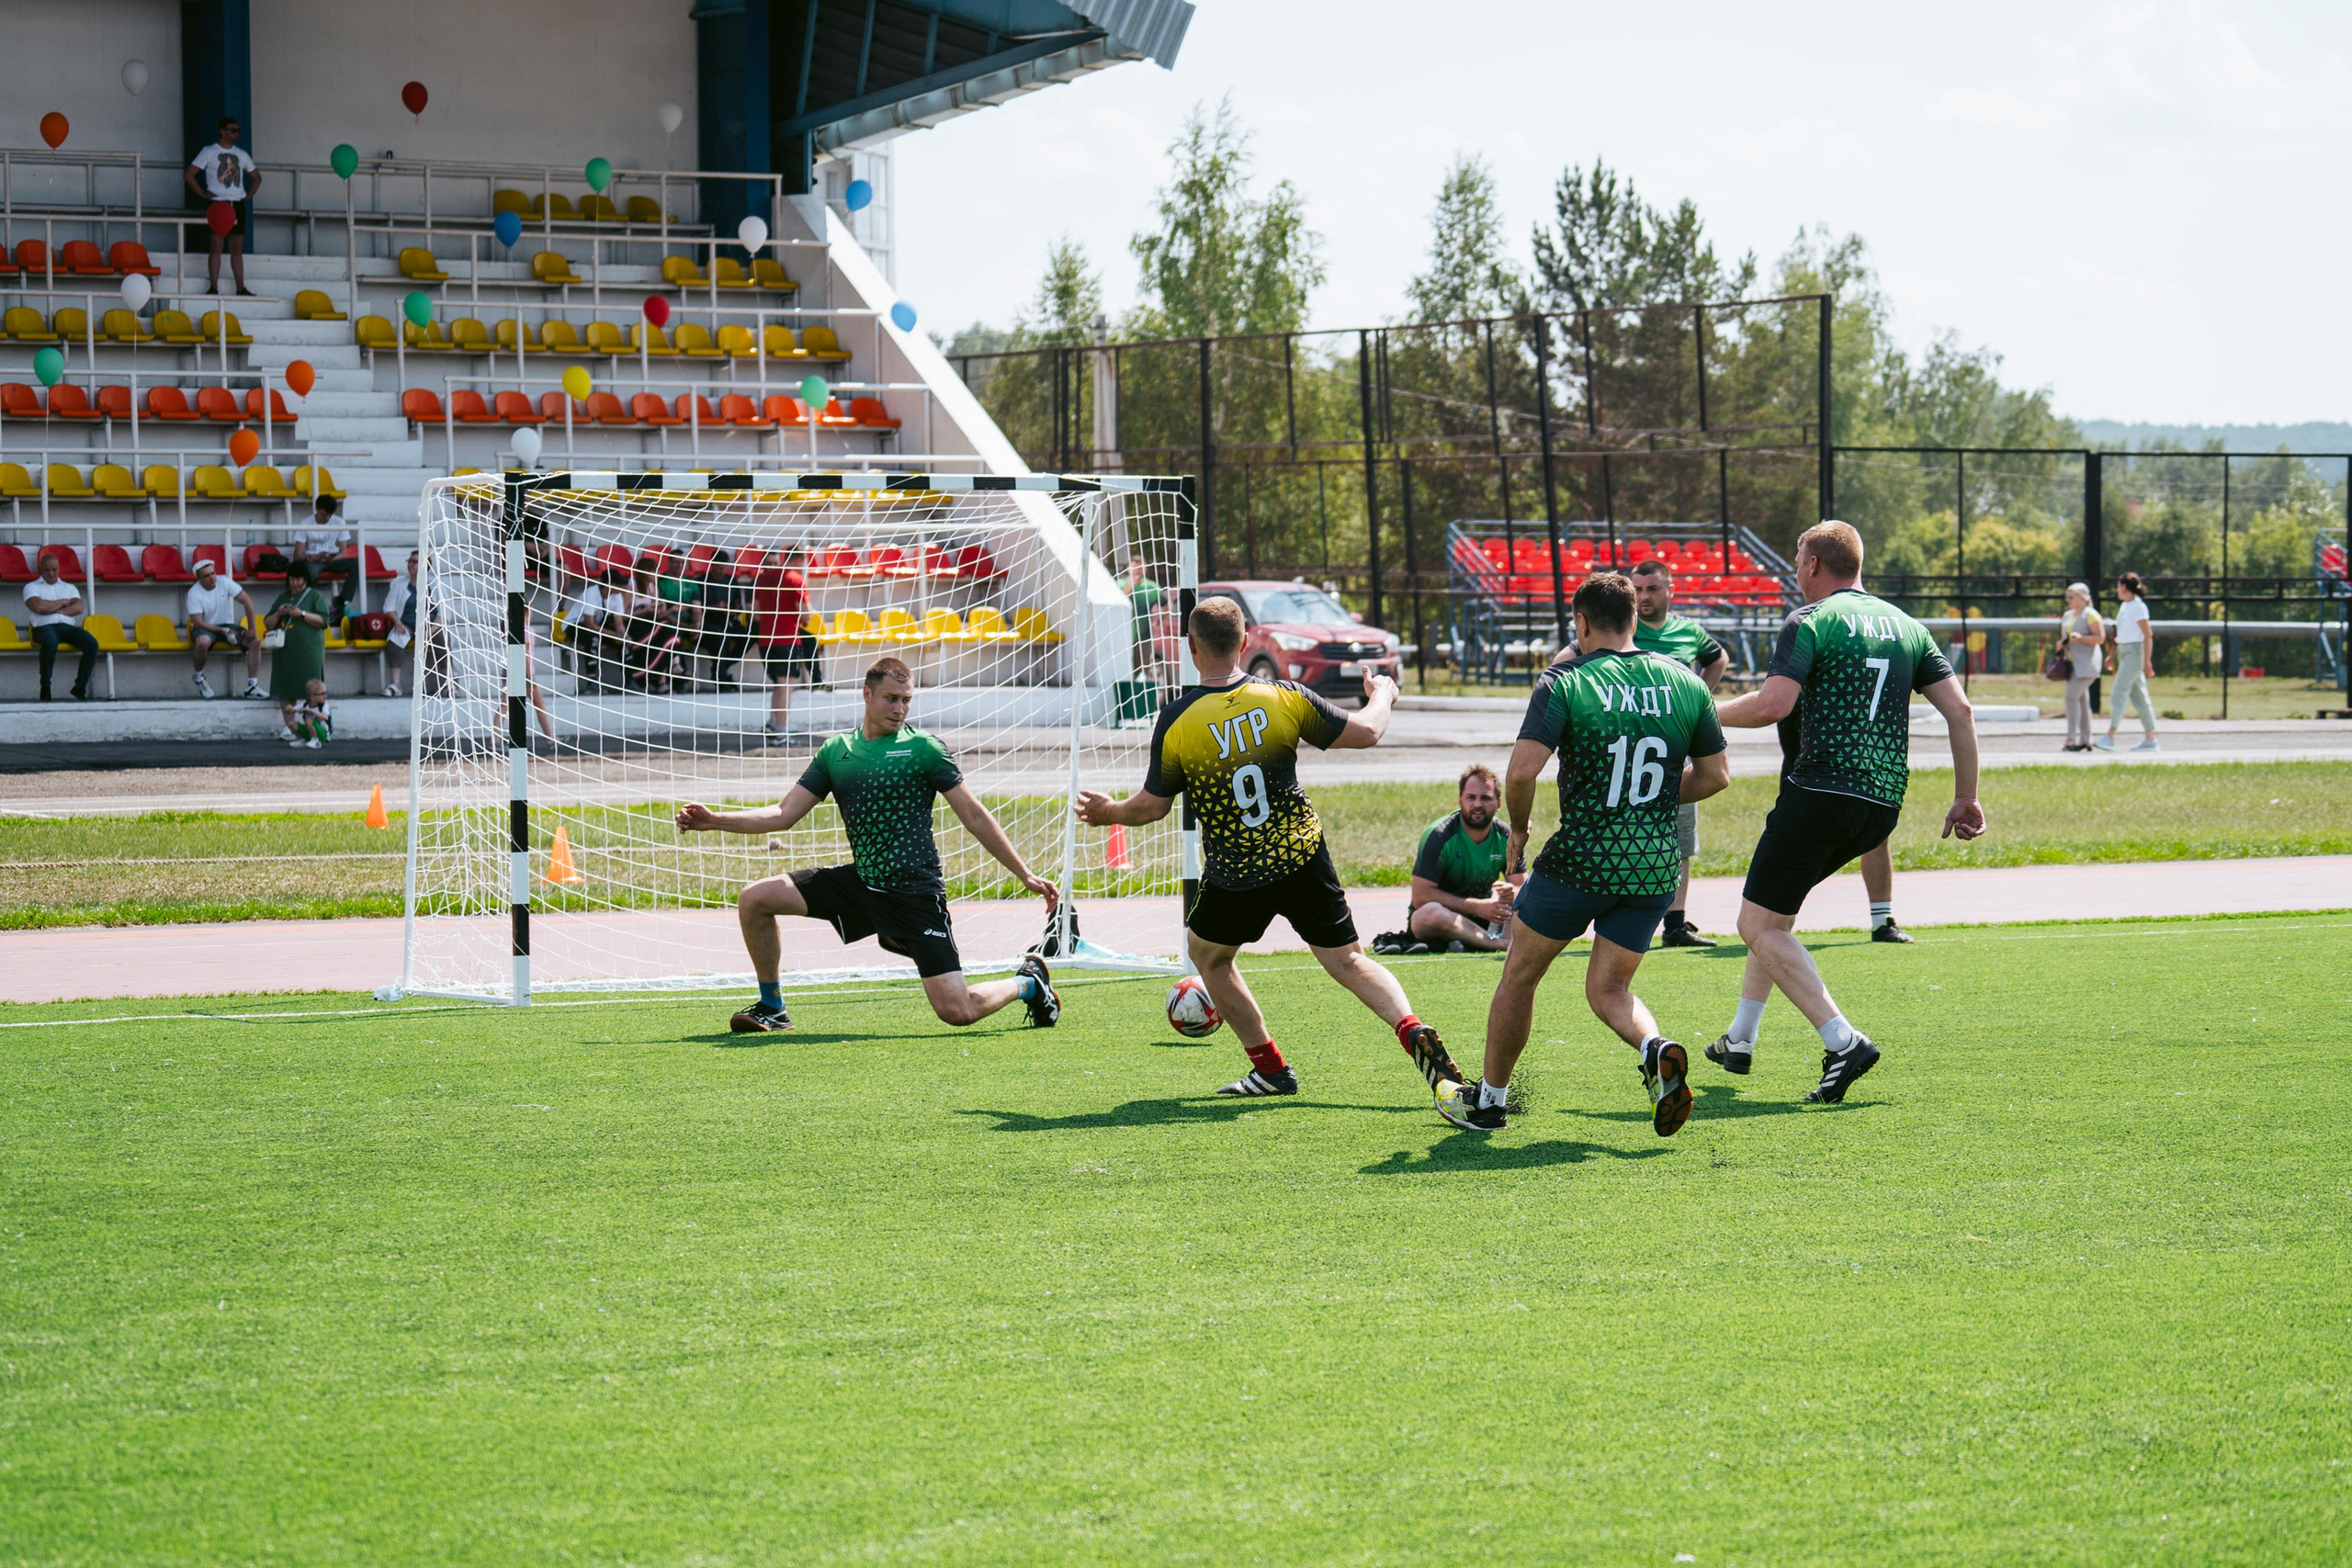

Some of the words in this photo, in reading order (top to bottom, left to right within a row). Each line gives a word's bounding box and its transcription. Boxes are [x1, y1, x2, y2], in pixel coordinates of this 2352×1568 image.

[1840, 613, 1904, 642] УЖДТ
[1596, 683, 1672, 718] УЖДТ
[1865, 657, 1890, 722] 7
[1207, 706, 1269, 761] УГР
[1232, 763, 1270, 828] 9
[1606, 735, 1668, 808] 16
